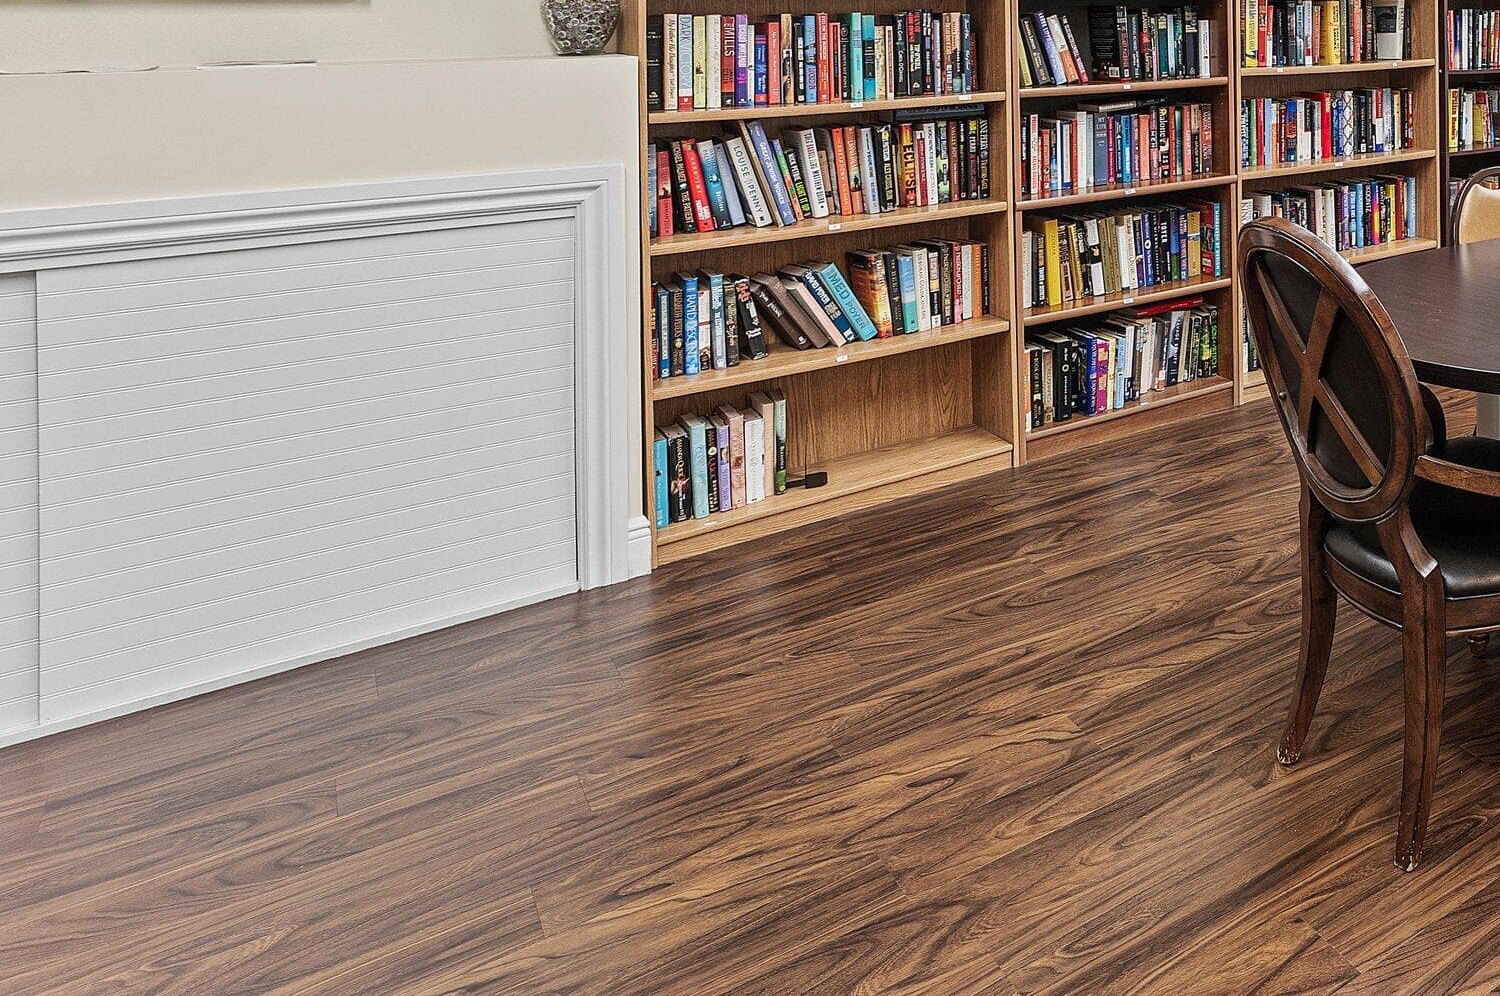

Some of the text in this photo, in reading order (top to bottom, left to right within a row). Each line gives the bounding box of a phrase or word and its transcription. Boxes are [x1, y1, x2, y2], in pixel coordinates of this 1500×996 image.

[680, 17, 691, 41] DARK
[724, 27, 735, 56] MILLS
[733, 145, 763, 214] LOUISE PENNY
[765, 159, 778, 182] JEWISH
[773, 182, 786, 205] WOMEN
[903, 145, 916, 195] ECLIPSE
[682, 202, 694, 224] PATIENT
[828, 273, 866, 329] MED POYER
[685, 294, 697, 359] RAPID DESCENT
